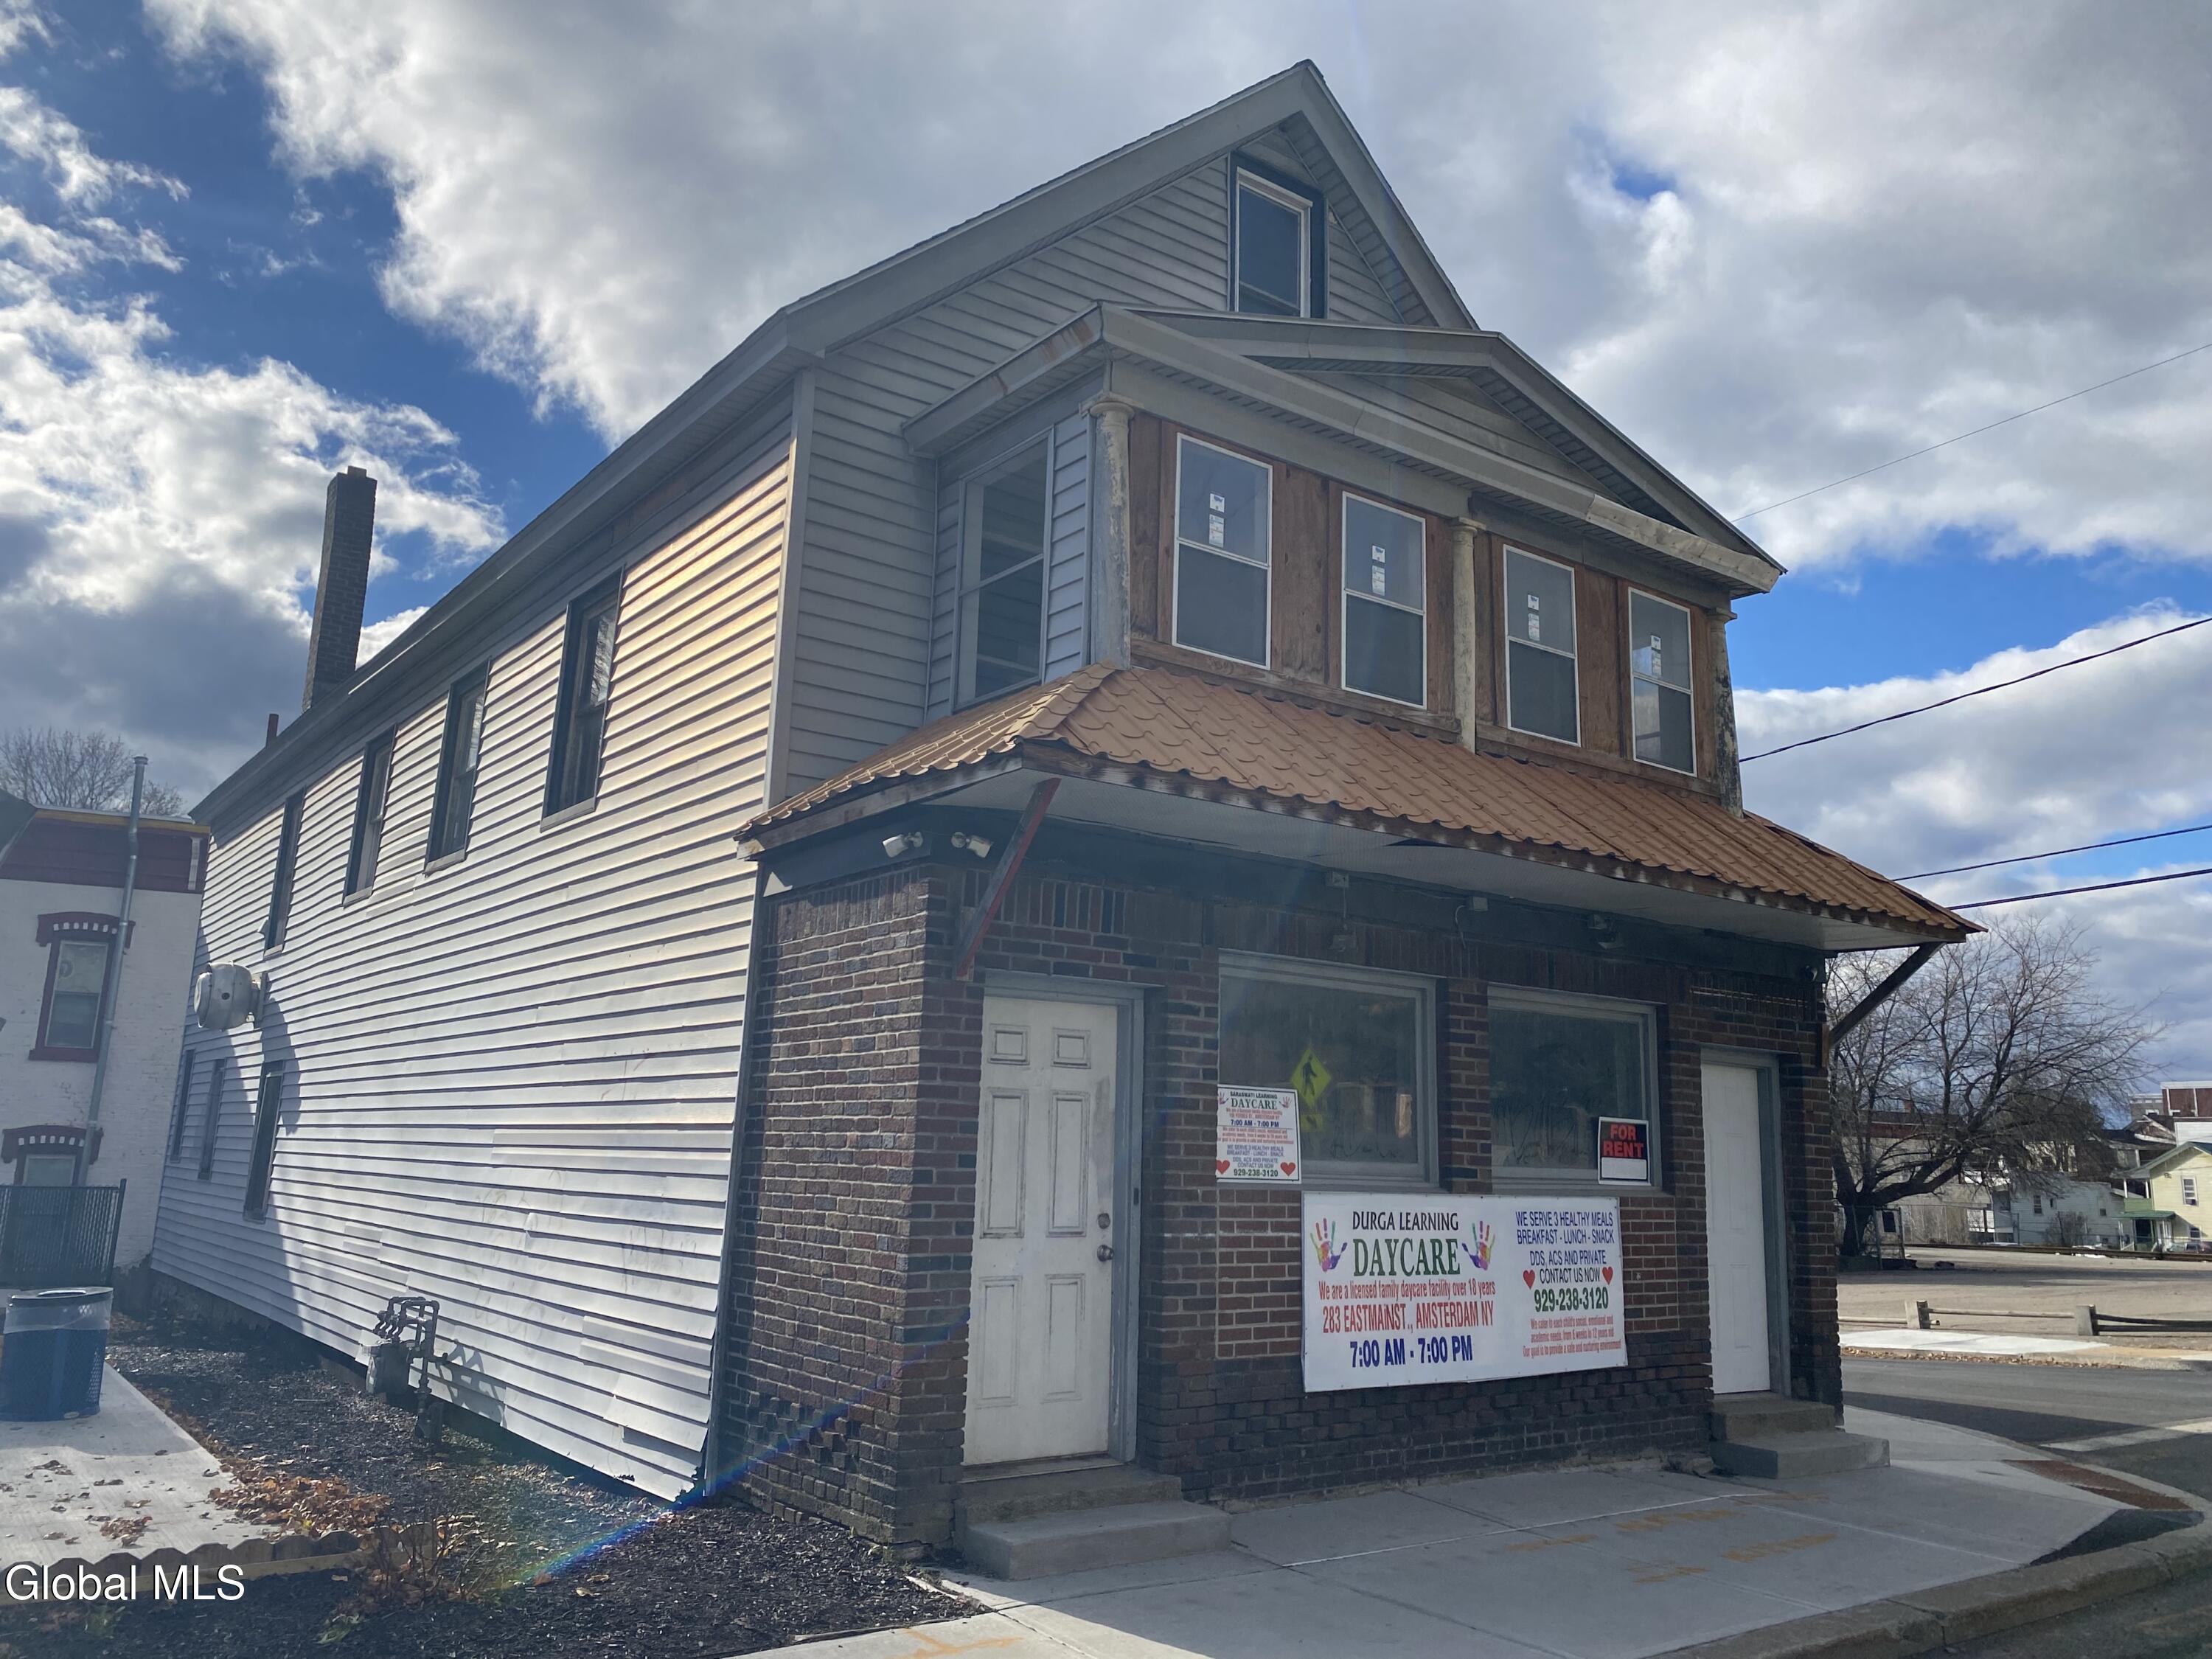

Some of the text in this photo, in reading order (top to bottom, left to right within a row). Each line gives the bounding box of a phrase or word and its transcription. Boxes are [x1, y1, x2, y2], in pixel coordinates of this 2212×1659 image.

[1231, 1097, 1277, 1110] DAYCARE
[1610, 1124, 1636, 1140] FOR
[1603, 1140, 1644, 1158] RENT
[1234, 1169, 1279, 1177] 929-238-3120
[1352, 1211, 1458, 1231] DURGA LEARNING
[1516, 1211, 1613, 1227] WE SERVE 3 HEALTHY MEALS
[1517, 1229, 1557, 1245] BREAKFAST
[1564, 1229, 1587, 1244] LUNCH
[1591, 1229, 1615, 1243] SNACK
[1353, 1238, 1461, 1276] DAYCARE
[1549, 1250, 1562, 1265] ACS
[1565, 1250, 1578, 1265] AND
[1579, 1250, 1607, 1265] PRIVATE
[1540, 1267, 1600, 1284] CONTACT US NOW
[1318, 1279, 1496, 1301] We are a licensed family daycare facility over 18 years
[1534, 1287, 1609, 1312] 929-238-3120
[1323, 1305, 1340, 1333] 283
[1416, 1301, 1478, 1328] AMSTERDAM
[1481, 1301, 1494, 1326] NY
[1350, 1340, 1380, 1368] 7:00
[1384, 1338, 1405, 1366] AM
[1418, 1336, 1448, 1364] 7:00
[1452, 1335, 1473, 1362] PM
